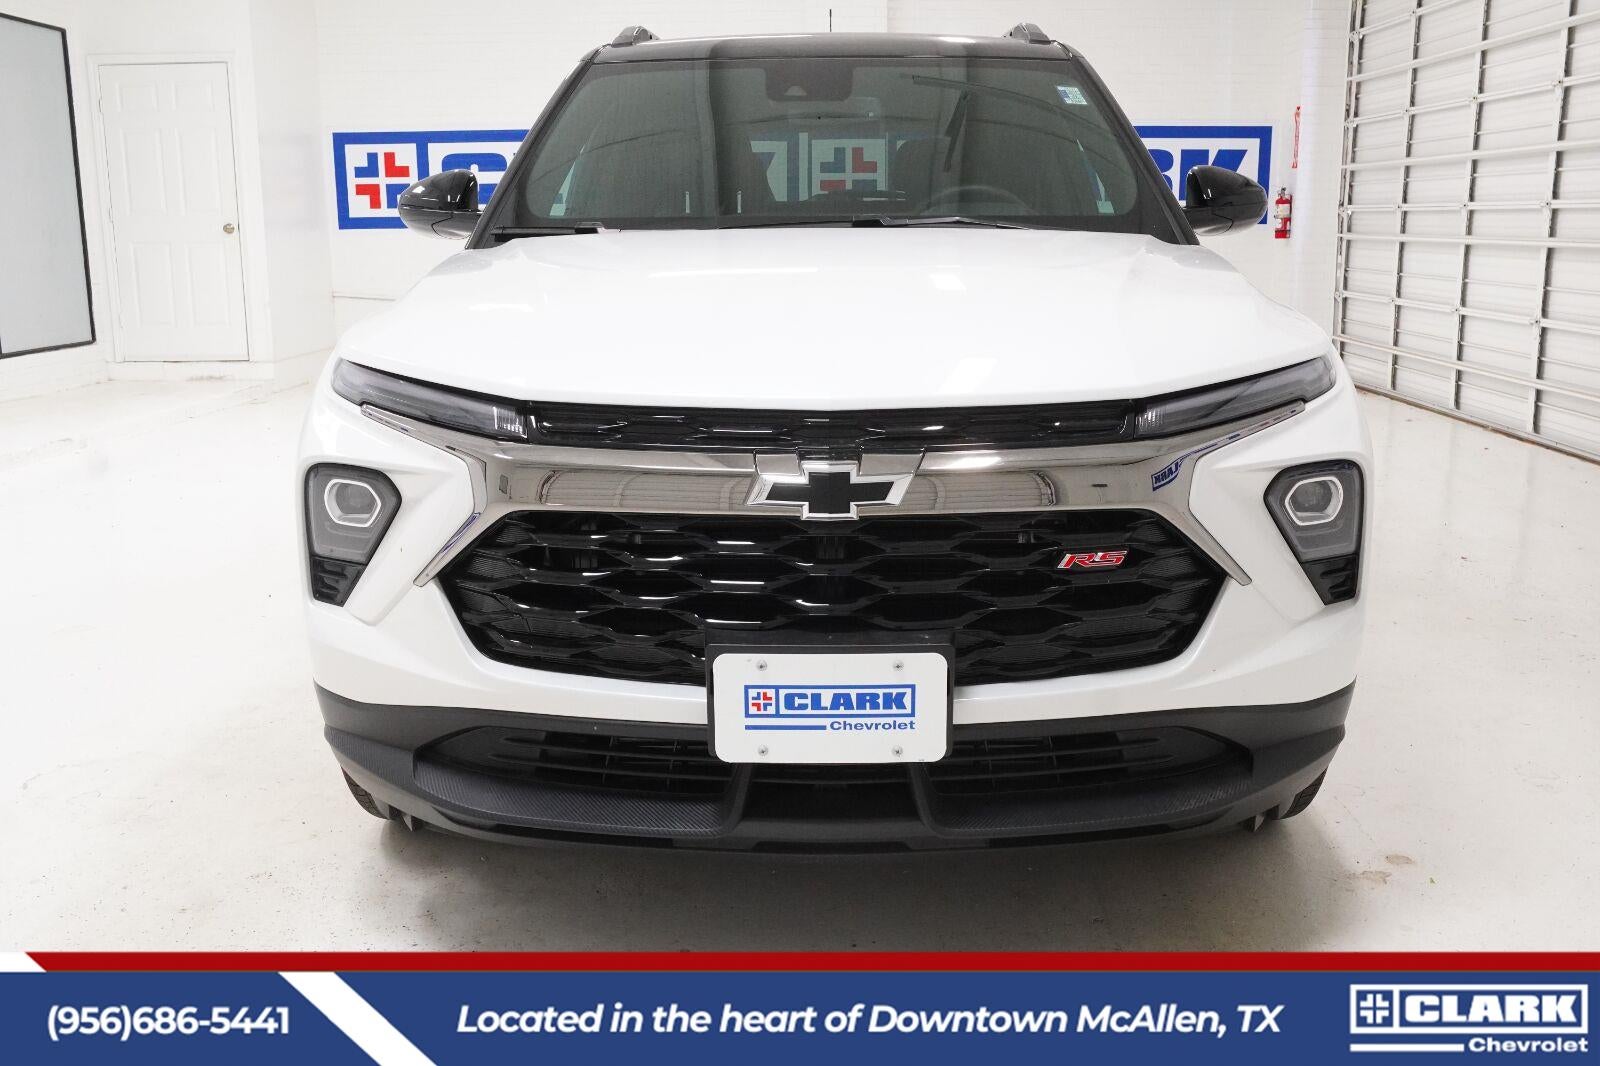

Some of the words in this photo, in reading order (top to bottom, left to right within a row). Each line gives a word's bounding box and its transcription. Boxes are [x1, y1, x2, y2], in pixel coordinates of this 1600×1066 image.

[1057, 551, 1127, 568] RS
[784, 692, 907, 711] CLARK
[830, 720, 916, 731] Chevrolet
